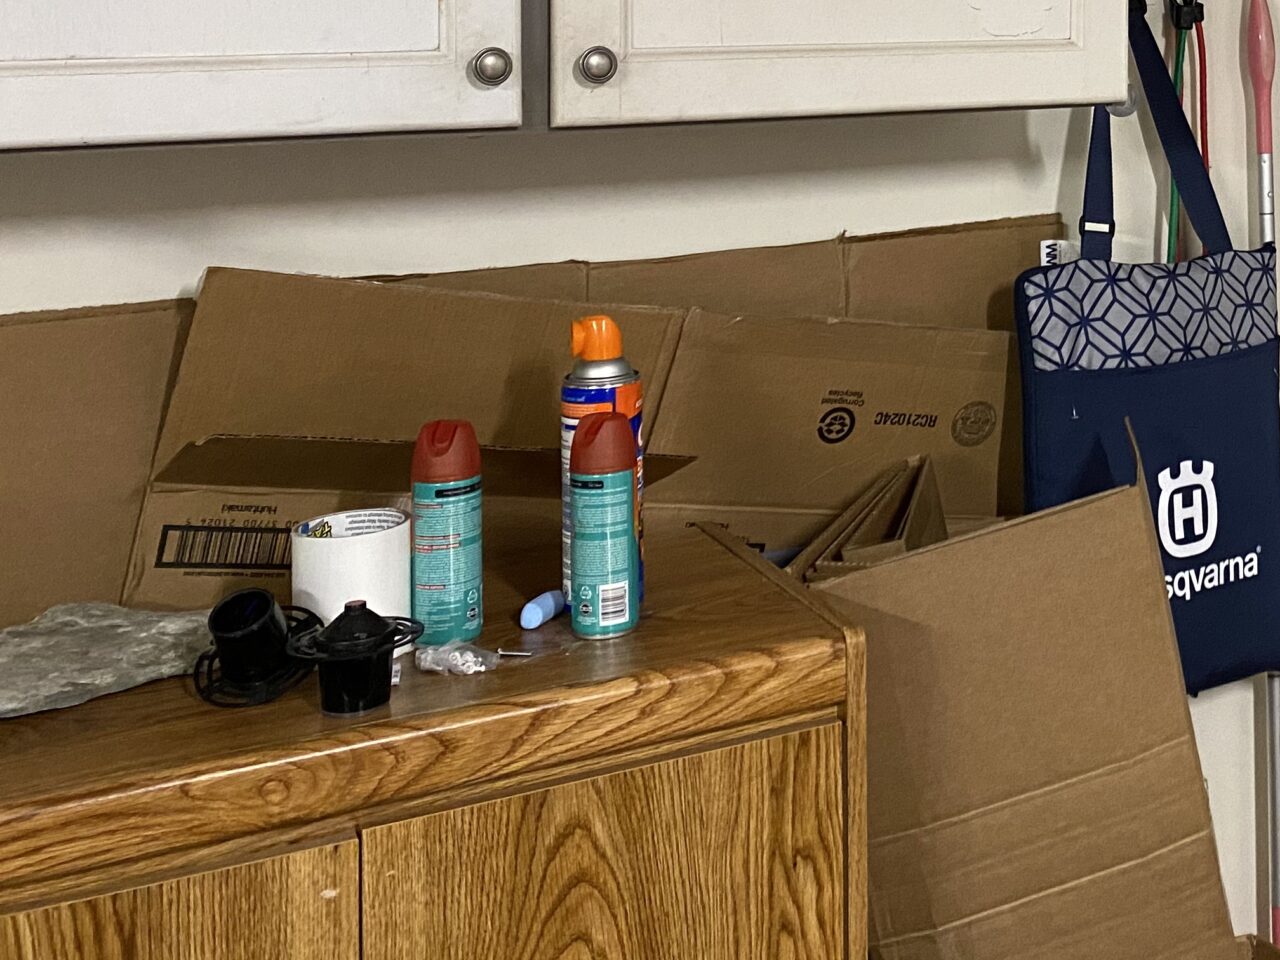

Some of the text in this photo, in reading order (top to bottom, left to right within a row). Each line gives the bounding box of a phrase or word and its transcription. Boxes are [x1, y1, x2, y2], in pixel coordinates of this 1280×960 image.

[873, 411, 938, 428] RC21024C
[221, 503, 278, 515] Huhtamaki
[1164, 551, 1259, 601] sqvarna
